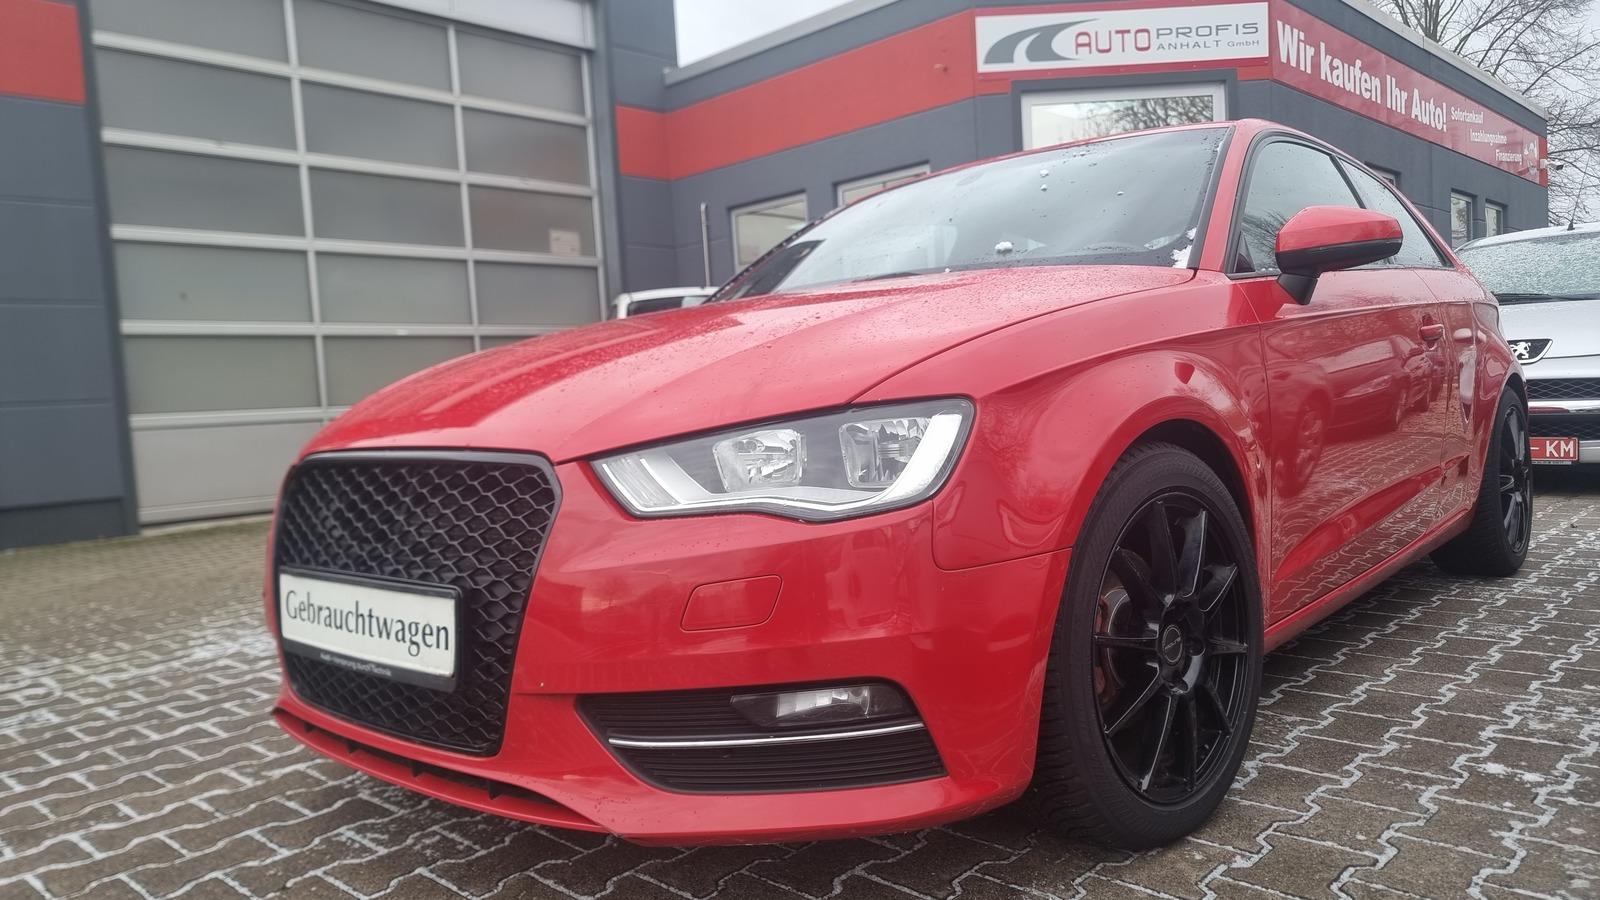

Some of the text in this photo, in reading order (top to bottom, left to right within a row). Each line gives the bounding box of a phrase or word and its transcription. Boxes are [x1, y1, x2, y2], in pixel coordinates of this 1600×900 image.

[1156, 39, 1260, 51] ANHALT GmbH
[1277, 20, 1447, 132] Wir kaufen Ihr Auto!
[1545, 440, 1574, 458] KM
[286, 589, 449, 657] Gebrauchtwagen
